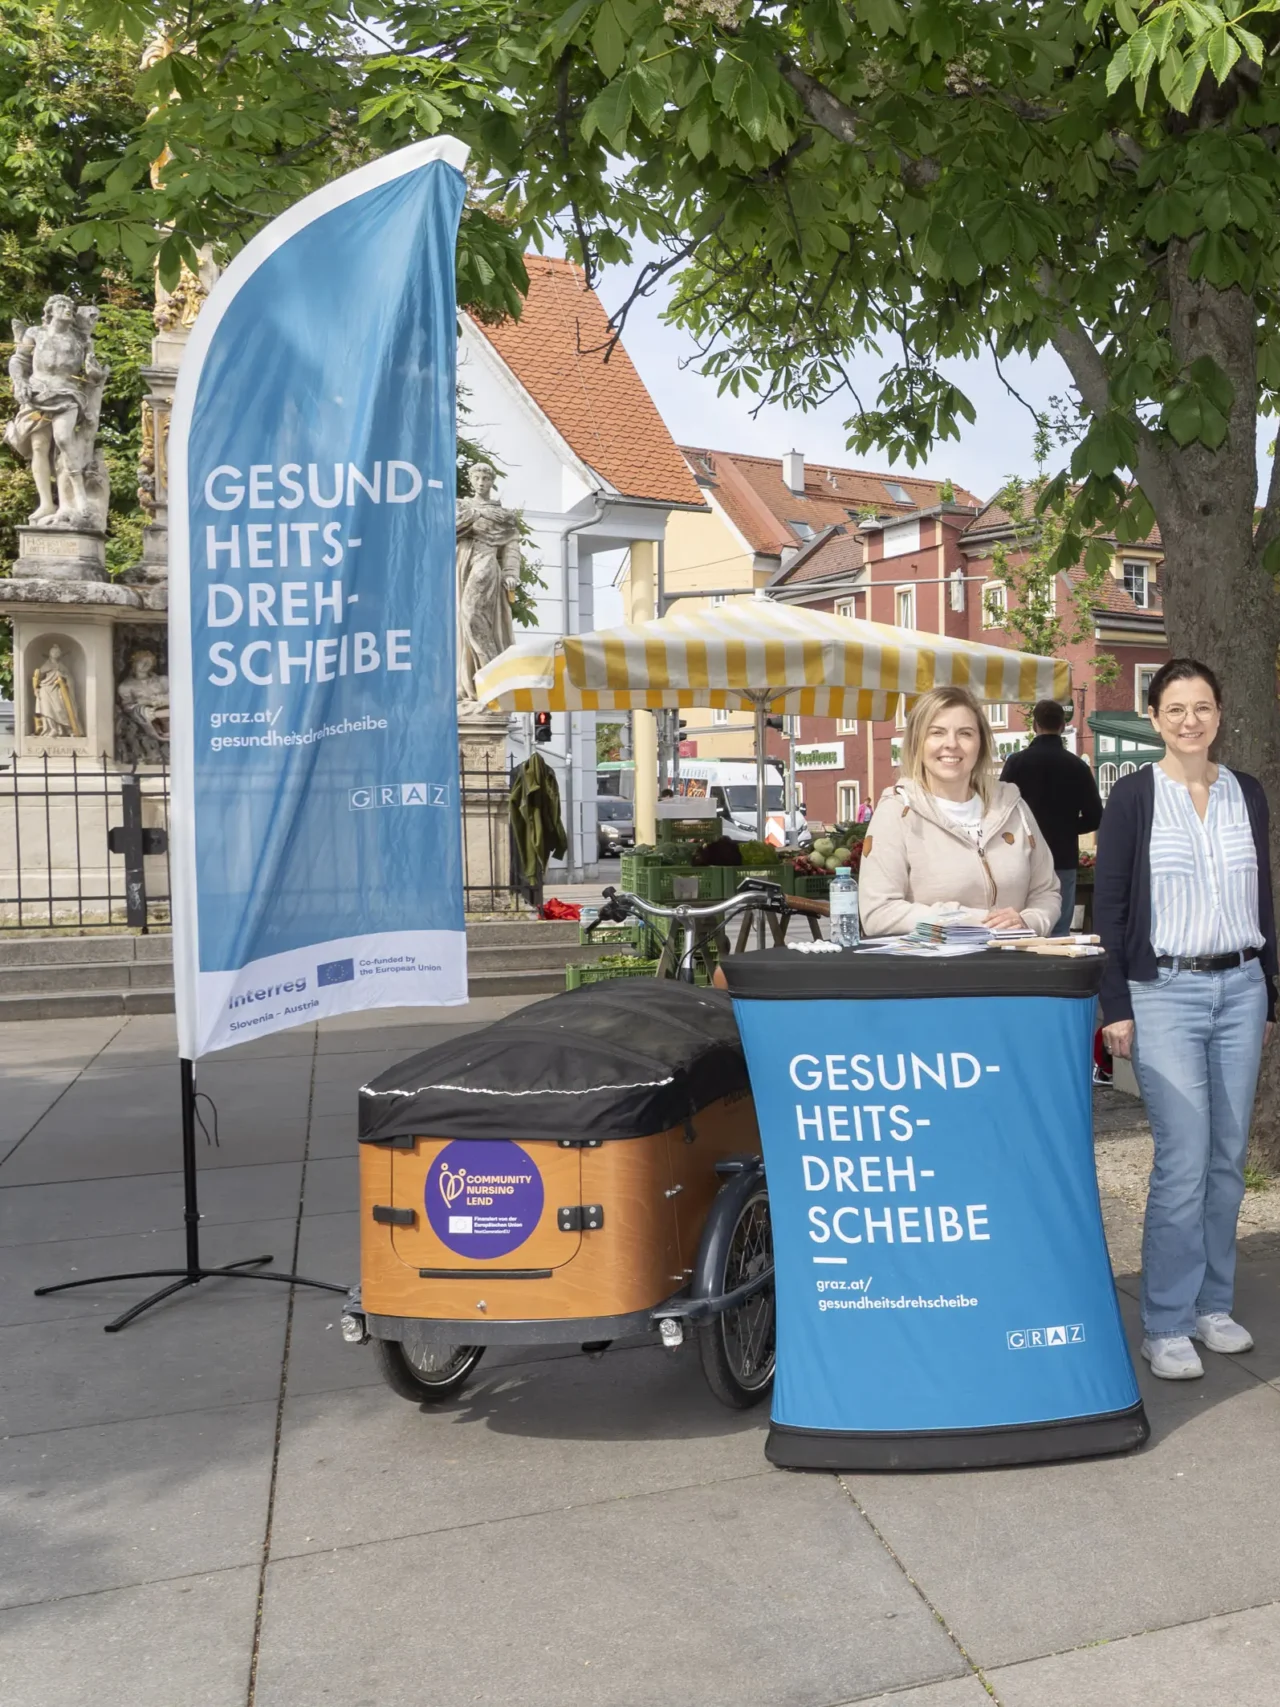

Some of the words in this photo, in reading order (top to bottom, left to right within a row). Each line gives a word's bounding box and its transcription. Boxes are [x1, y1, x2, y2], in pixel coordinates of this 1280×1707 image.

[204, 460, 443, 511] GESUND-
[206, 521, 362, 569] HEITS-
[207, 580, 359, 628] DREH-
[208, 629, 412, 686] SCHEIBE
[210, 705, 283, 728] graz.at/
[351, 784, 446, 809] GRAZ
[359, 956, 404, 967] Co-funded
[360, 968, 374, 976] the
[375, 965, 416, 974] European
[418, 964, 442, 972] Union
[229, 977, 306, 1009] Interreg
[229, 1012, 274, 1031] Slovenia
[284, 999, 320, 1015] Austria
[789, 1052, 1000, 1091] GESUND-
[796, 1104, 931, 1141] HEITS-
[466, 1175, 532, 1184] COMMUNITY
[802, 1155, 935, 1192] DREH-
[466, 1185, 515, 1195] NURSING
[466, 1197, 493, 1206] LEND
[808, 1204, 990, 1244] SCHEIBE
[816, 1277, 872, 1293] graz.at/
[818, 1294, 979, 1311] gesundheitsdrehscheibe
[1008, 1325, 1083, 1349] GRAZ
